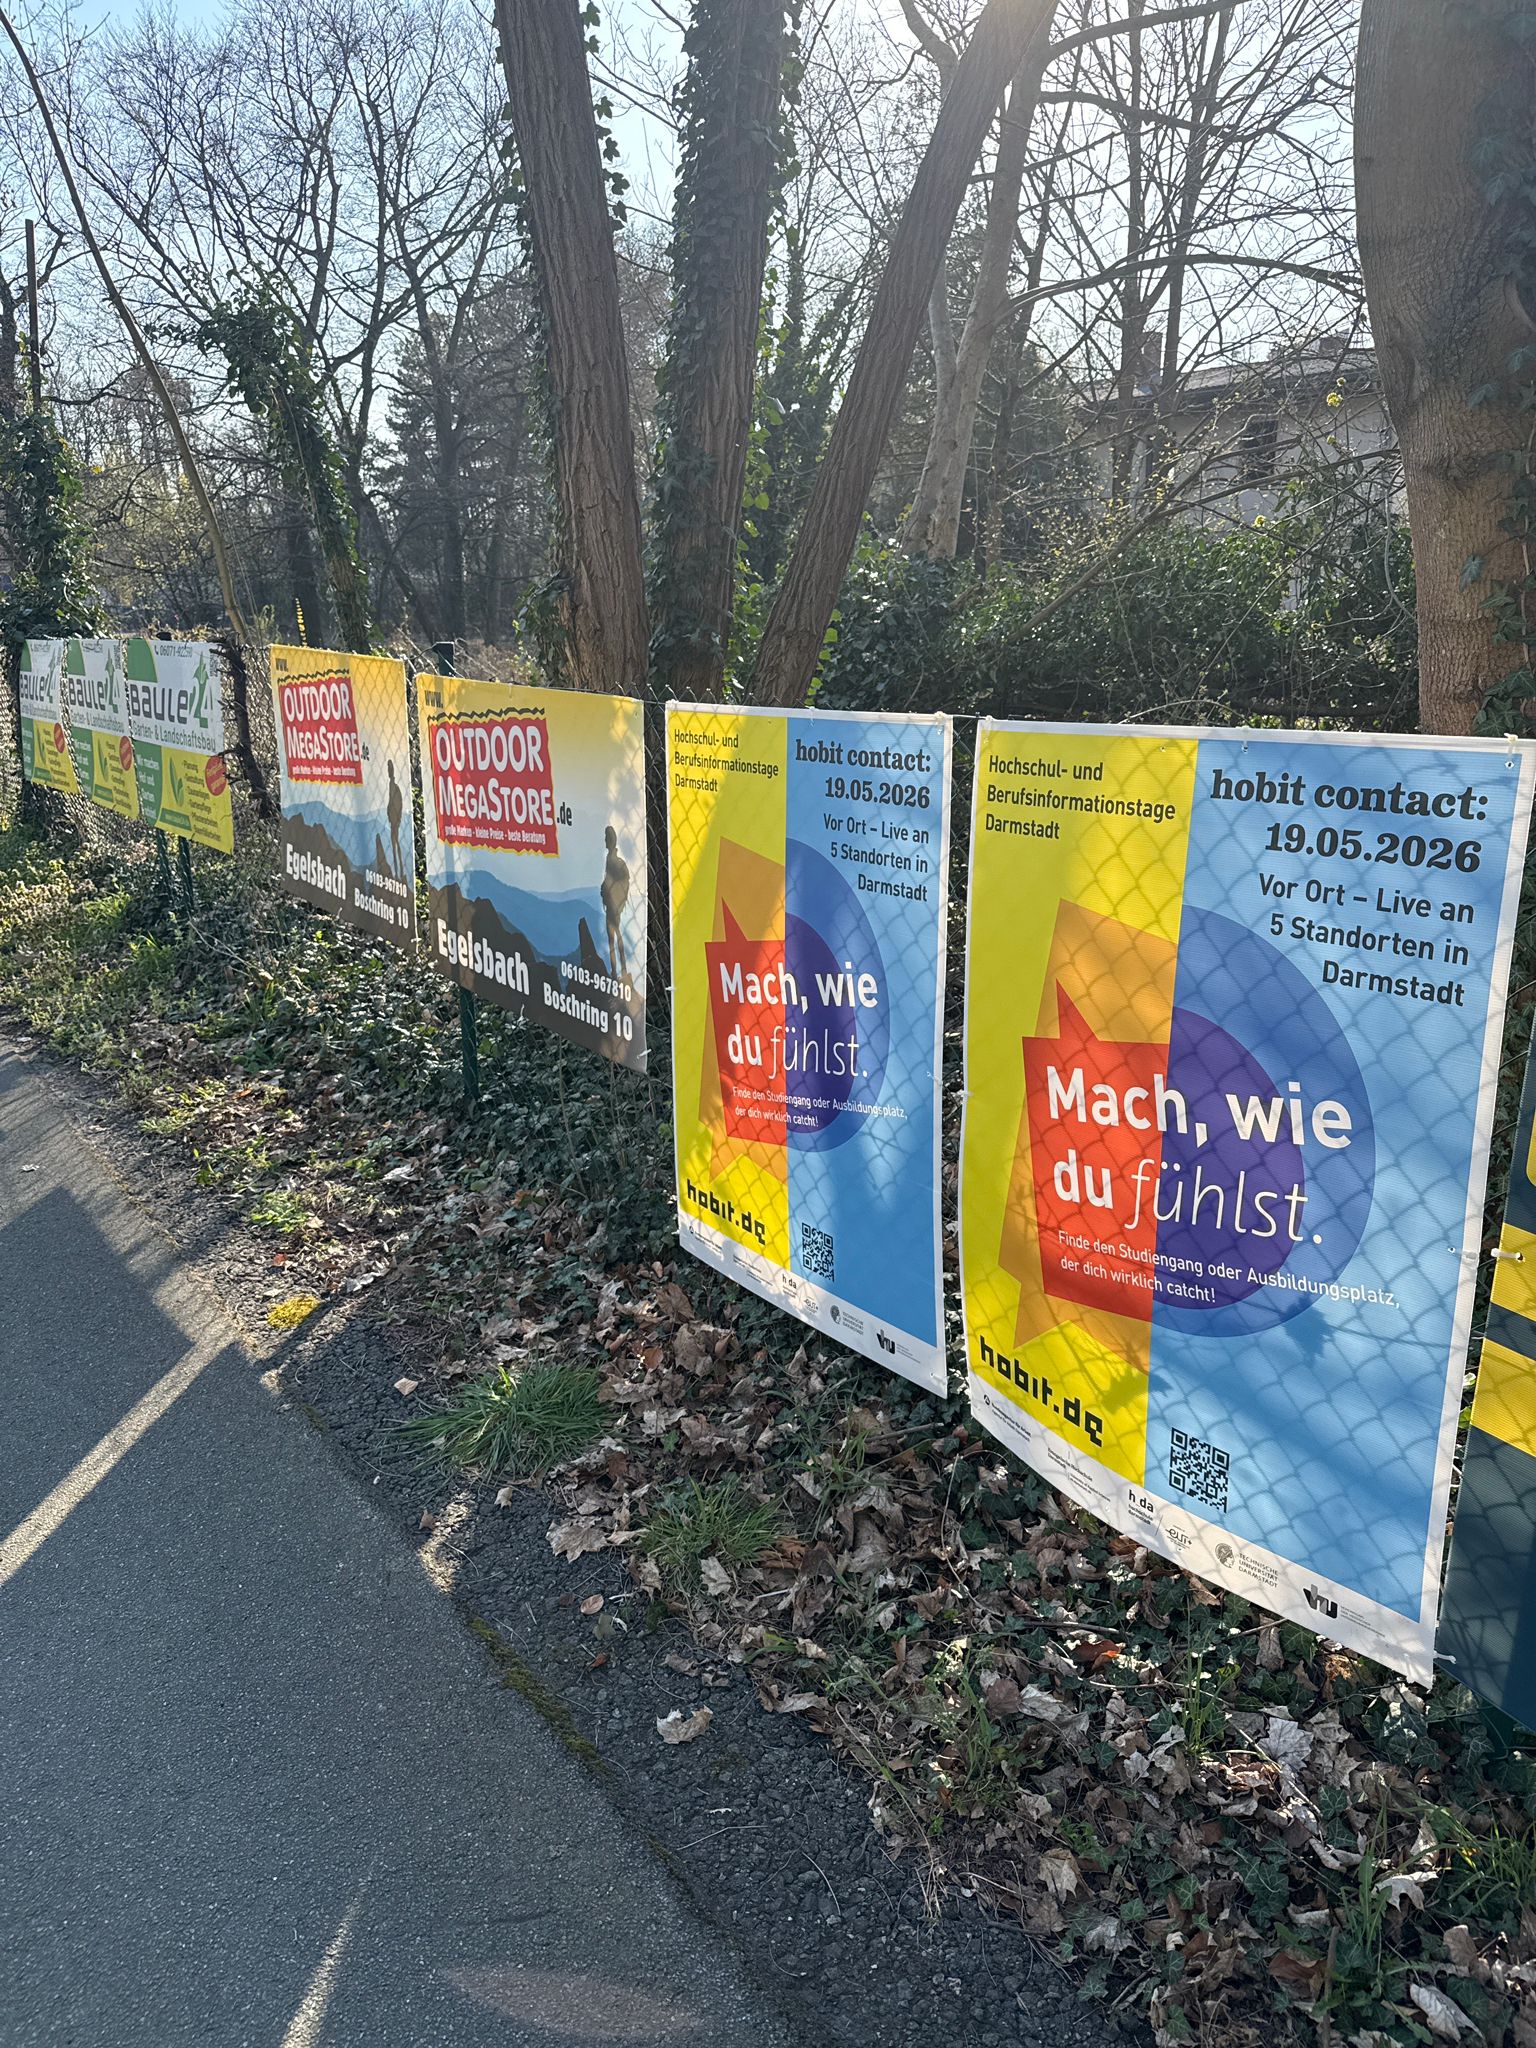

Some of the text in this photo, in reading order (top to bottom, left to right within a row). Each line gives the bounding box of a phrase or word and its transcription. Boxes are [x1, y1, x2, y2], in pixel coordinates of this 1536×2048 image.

[284, 683, 352, 722] OUTDOOR
[161, 726, 216, 752] Landschaftsbau
[436, 725, 545, 772] OUTDOOR
[674, 729, 739, 748] Hochschul- und
[795, 739, 931, 772] hobit contact:
[674, 752, 779, 779] Berufsinformationstage
[675, 774, 718, 792] Darmstadt
[989, 755, 1103, 781] Hochschul- und
[825, 777, 930, 808] 19.05.2026
[987, 785, 1176, 823] Berufsinformationstage
[1210, 769, 1489, 821] hobit contact:
[522, 830, 546, 845] Beratung
[824, 813, 844, 832] Vor
[846, 816, 866, 835] Ort
[881, 822, 908, 841] Live
[912, 828, 929, 844] an
[985, 814, 1060, 839] Darmstadt
[830, 842, 928, 873] 5 Standorten in
[1265, 822, 1482, 873] 19.05.2026
[286, 843, 347, 900] Egelsbach
[858, 874, 927, 902] Darmstadt
[354, 888, 409, 929] Boschring 10
[1259, 873, 1299, 899] Vor
[1305, 879, 1345, 906] Ort
[1376, 888, 1432, 919] Live
[1439, 901, 1474, 923] an
[437, 918, 530, 995] Egelsbach
[1270, 913, 1469, 965] 5 Standorten in
[561, 961, 632, 1002] 06103-967810
[719, 961, 878, 1014] Mach, wie
[1322, 960, 1465, 1007] Darmstadt
[543, 982, 633, 1041] Boschring 10
[727, 1024, 868, 1080] du fühlst.
[732, 1086, 908, 1119] Finde den Studiengang oder Ausbildungsplatz,
[735, 1107, 819, 1127] der dich wirklich catcht!
[1046, 1065, 1352, 1150] Mach, wie
[1053, 1149, 1322, 1244] du fühlst.
[1058, 1230, 1400, 1309] Finde den Studiengang oder Ausbildungsplatz,
[1060, 1255, 1216, 1303] der dich wirklich catcht!
[1238, 1566, 1278, 1588] DARMSTADT
[1239, 1553, 1278, 1576] TECHNISCHE
